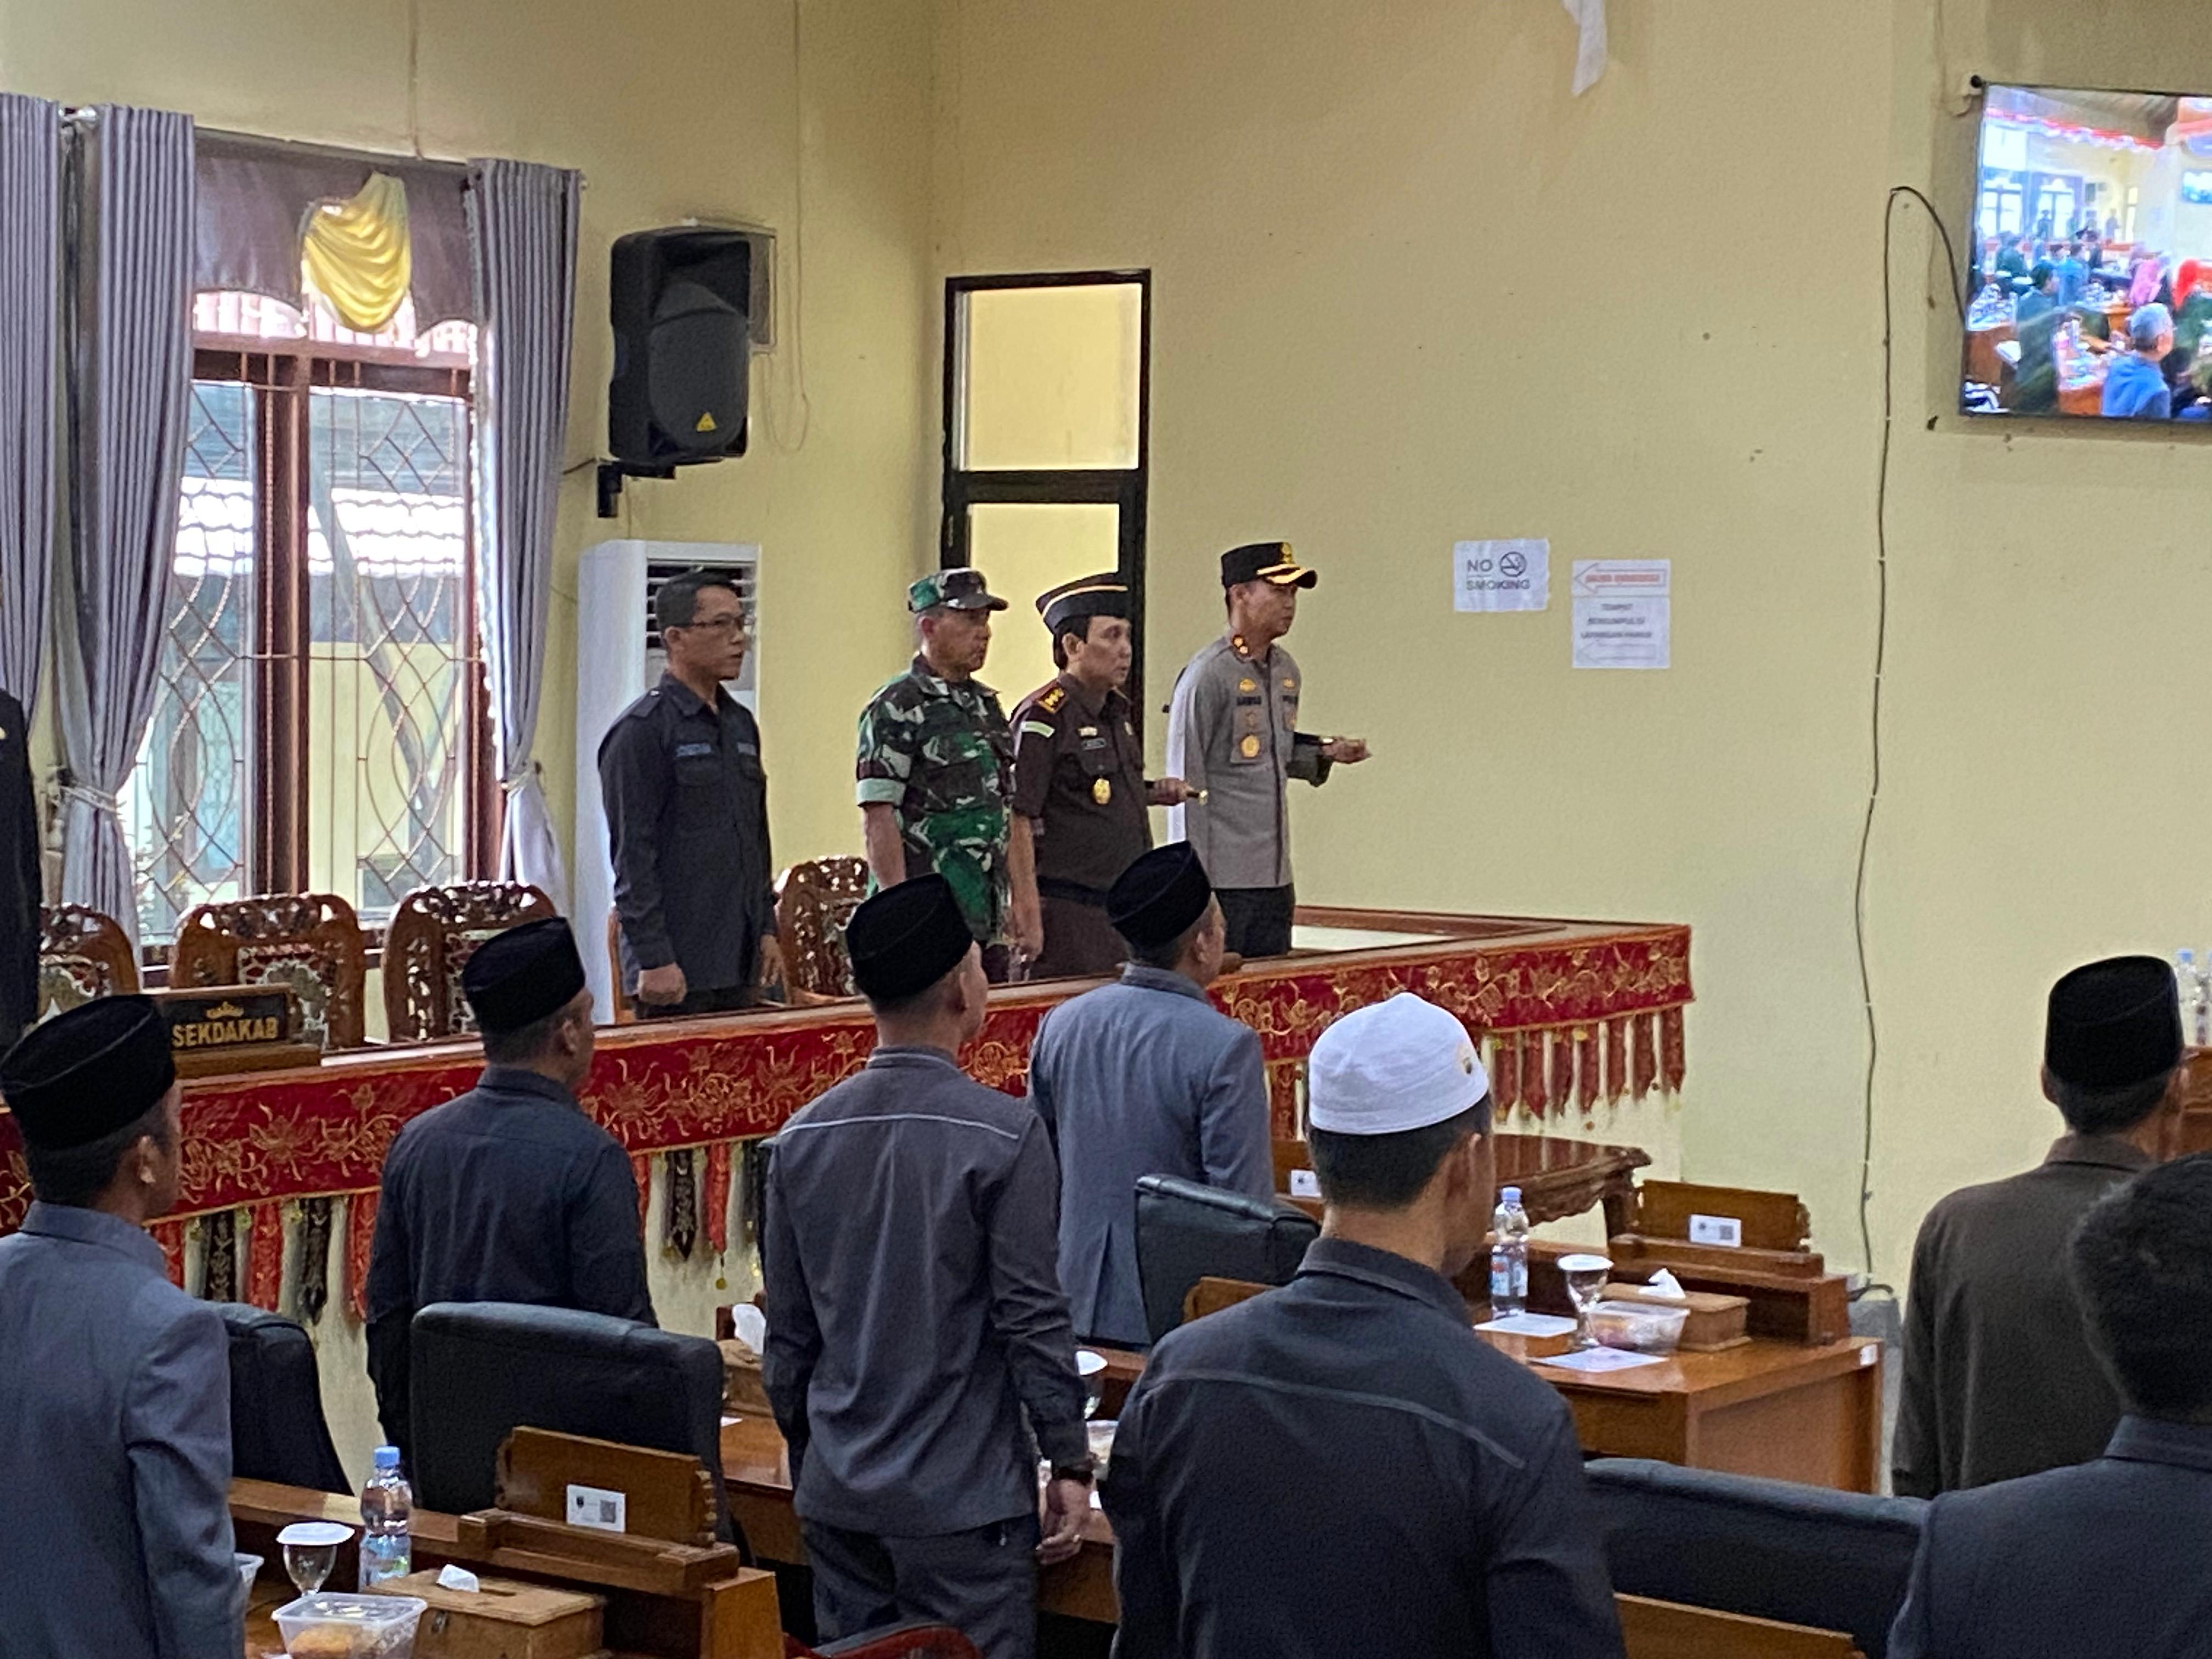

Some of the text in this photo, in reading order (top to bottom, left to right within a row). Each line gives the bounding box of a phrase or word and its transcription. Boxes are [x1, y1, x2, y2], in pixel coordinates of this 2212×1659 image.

[1467, 559, 1493, 572] NO
[1466, 579, 1531, 591] SMOKING
[172, 1017, 278, 1048] SEKDAKAB
